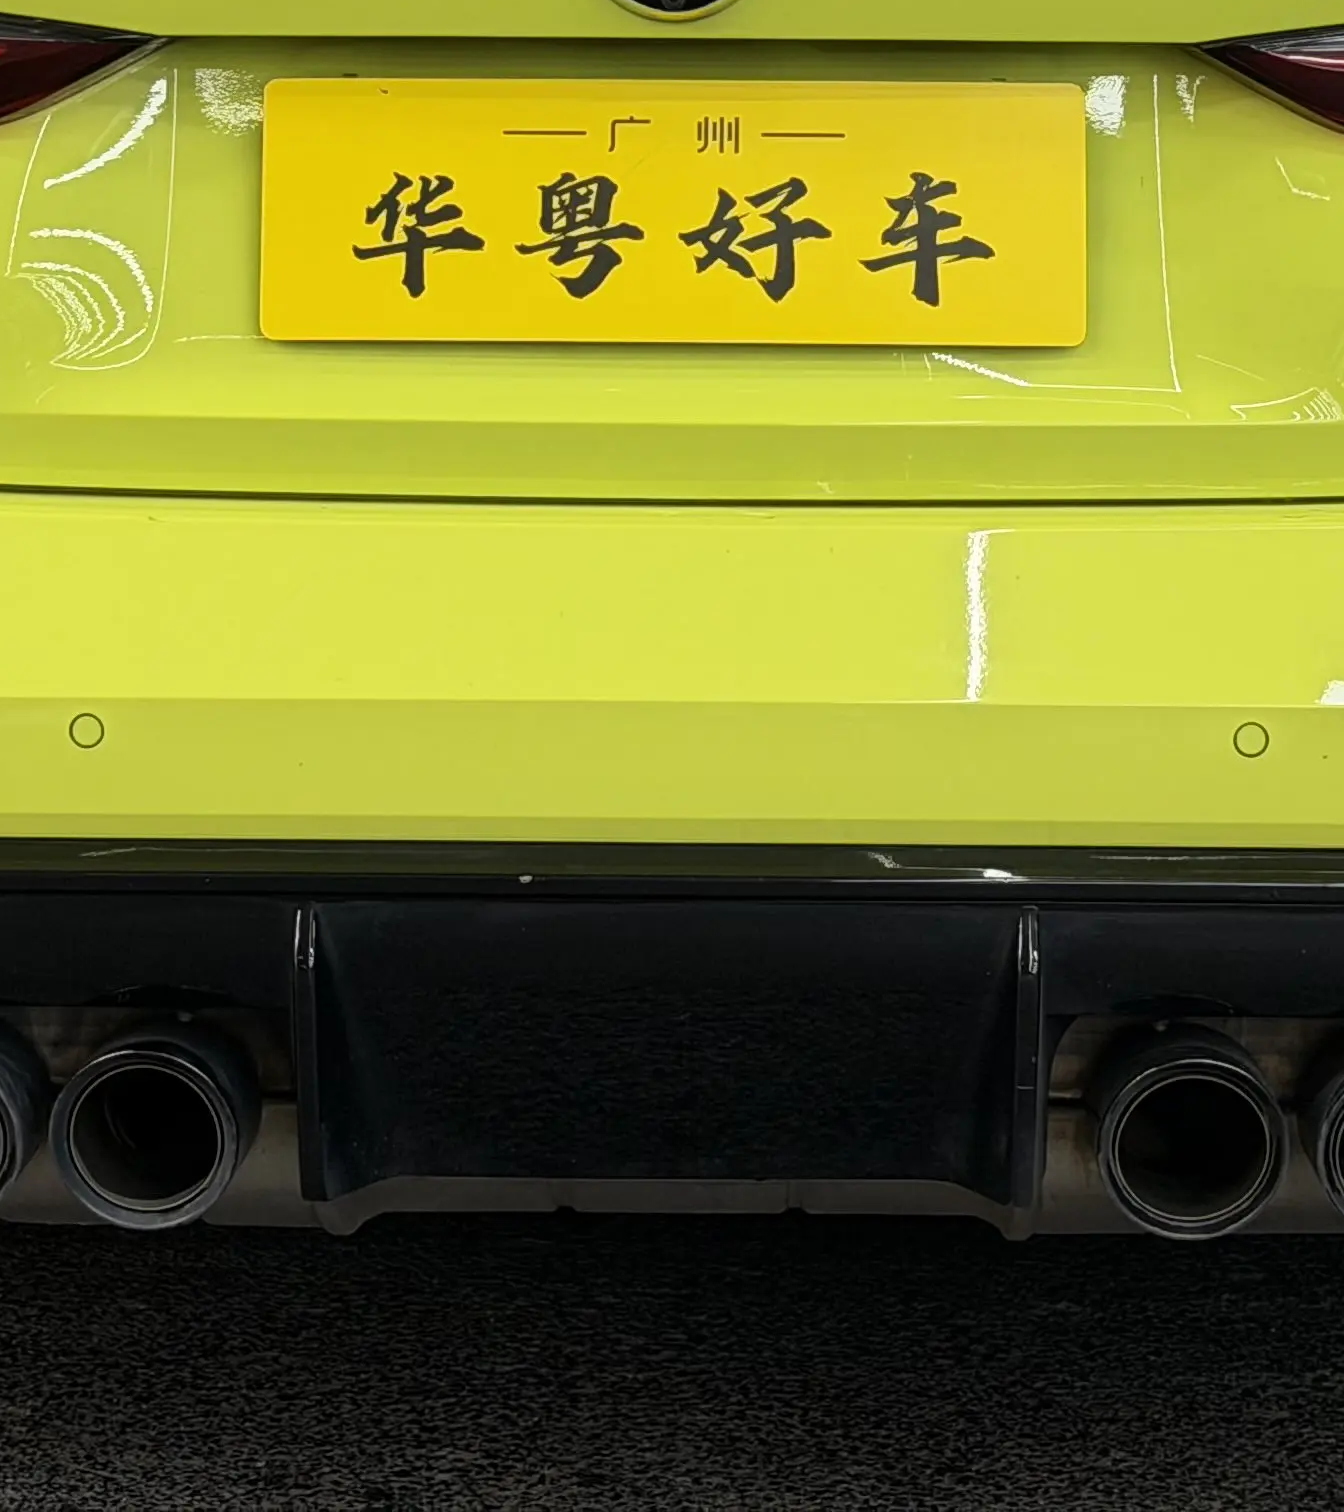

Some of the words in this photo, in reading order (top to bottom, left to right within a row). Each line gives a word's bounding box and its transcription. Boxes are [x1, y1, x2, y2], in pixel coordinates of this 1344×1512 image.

[607, 115, 742, 155] 广州
[351, 171, 996, 308] 华粤好车
